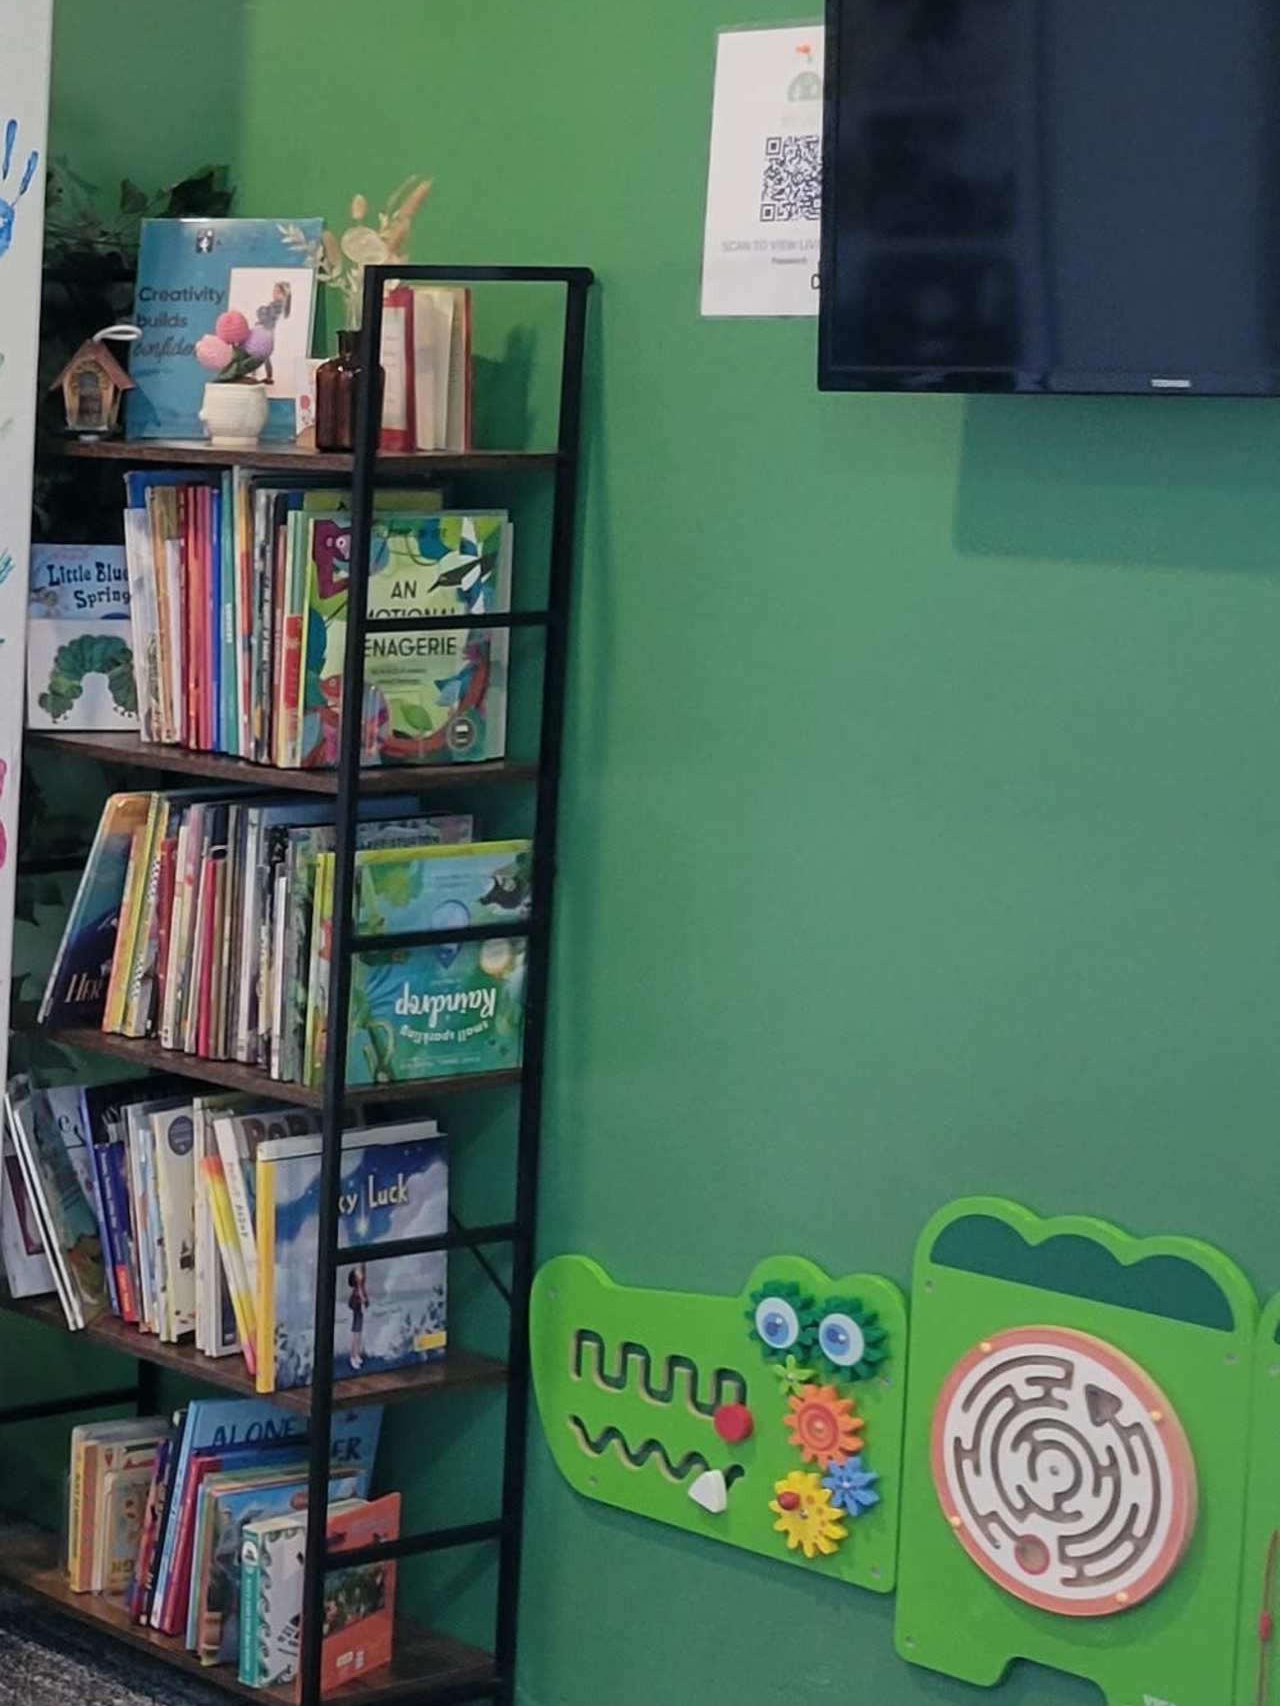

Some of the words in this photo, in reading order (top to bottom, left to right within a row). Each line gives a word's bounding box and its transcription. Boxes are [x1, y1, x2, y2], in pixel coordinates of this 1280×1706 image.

[139, 285, 225, 306] Creativity
[137, 312, 188, 329] builds
[46, 563, 92, 587] Little
[391, 580, 417, 599] AN
[364, 637, 457, 657] ENAGERIE
[395, 981, 496, 1028] Raindrop
[457, 1020, 489, 1042] small
[368, 1173, 409, 1208] Luck
